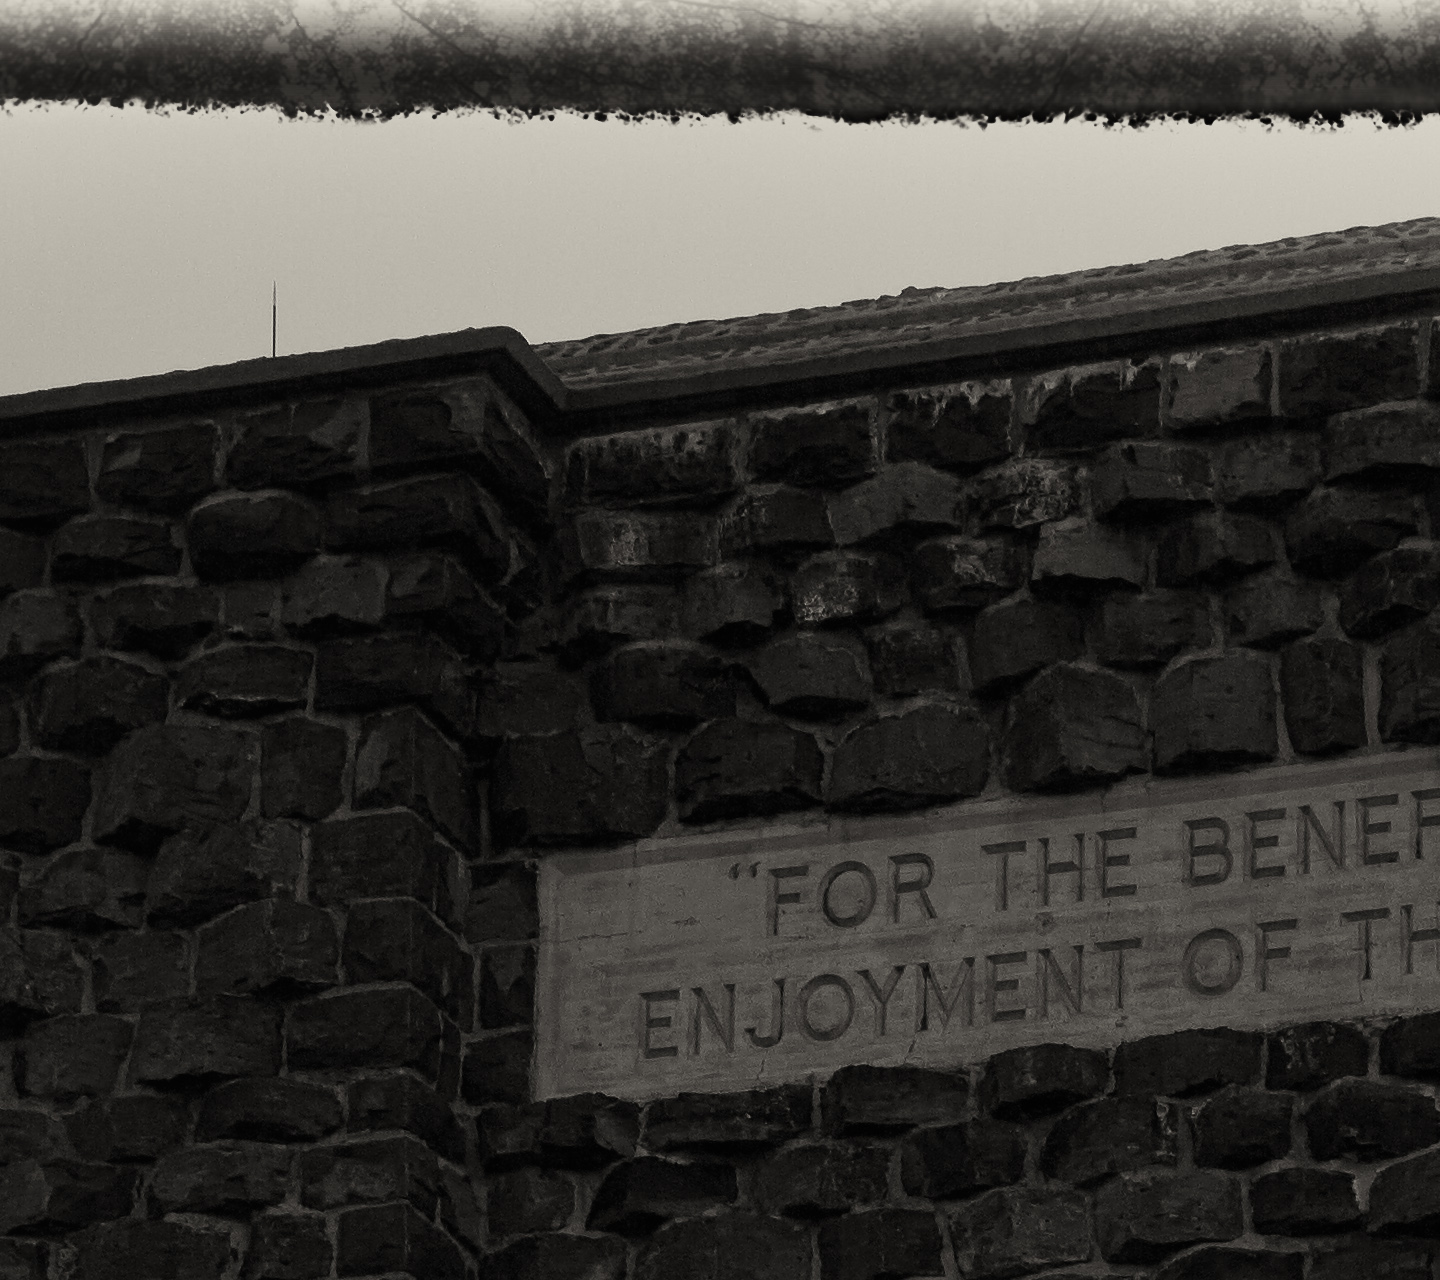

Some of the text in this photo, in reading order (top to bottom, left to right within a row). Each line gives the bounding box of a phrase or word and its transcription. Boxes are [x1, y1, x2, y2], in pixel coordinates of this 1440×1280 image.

[981, 828, 1138, 911] THE
[639, 936, 1142, 1060] ENJOYMENT
[1182, 918, 1298, 997] OF
